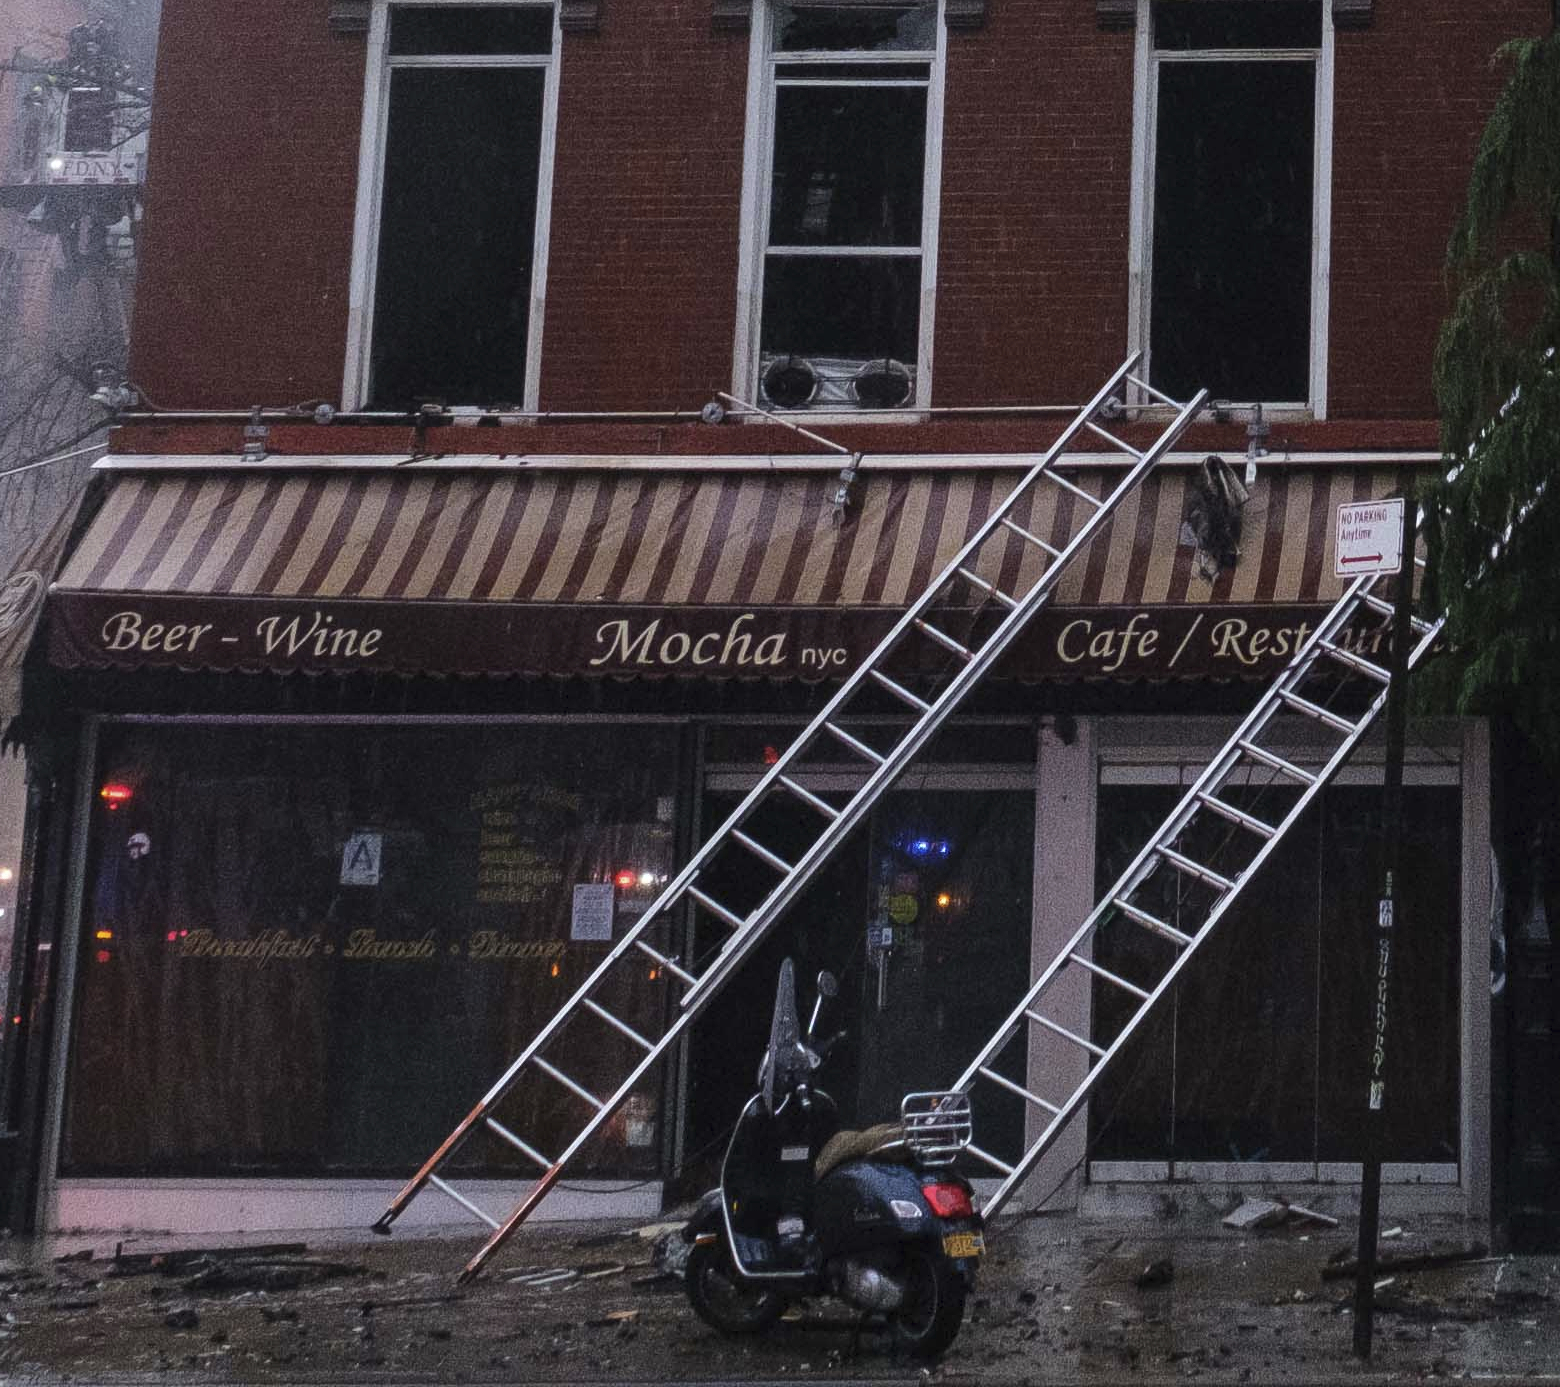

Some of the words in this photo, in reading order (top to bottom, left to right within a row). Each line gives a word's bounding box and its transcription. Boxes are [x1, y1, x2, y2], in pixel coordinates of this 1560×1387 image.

[1341, 513, 1352, 524] NO
[1354, 508, 1388, 524] PARKING
[1341, 528, 1372, 542] Anytime
[101, 611, 212, 653] Beer
[256, 610, 383, 658] Wine
[589, 613, 788, 667] Mocha
[801, 647, 847, 667] nyc
[1056, 613, 1160, 673] Cafe
[348, 840, 373, 871] A
